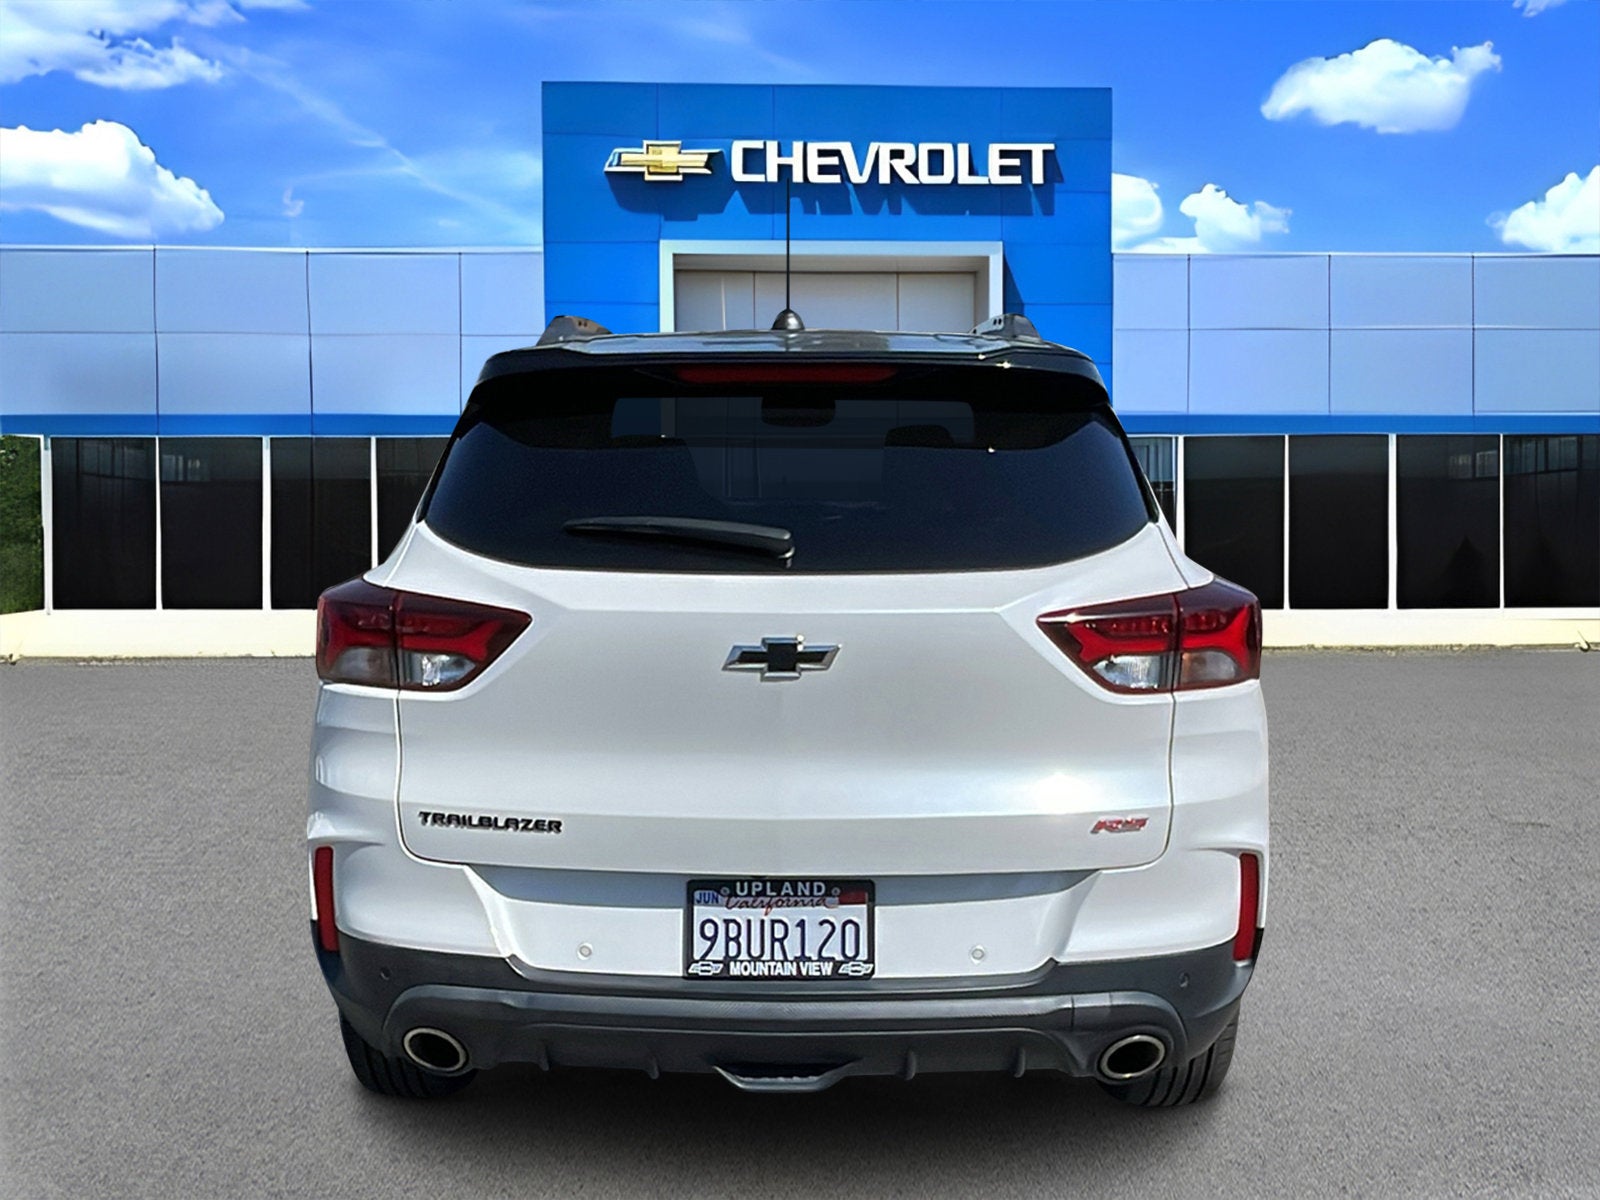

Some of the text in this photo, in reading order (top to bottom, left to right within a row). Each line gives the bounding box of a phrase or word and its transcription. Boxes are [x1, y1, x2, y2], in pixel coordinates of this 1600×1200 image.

[731, 140, 1054, 184] CHEVROLET
[419, 811, 562, 833] TRAILBLAZER
[736, 881, 826, 896] UPLAND
[695, 892, 719, 904] JUN
[699, 919, 860, 960] 9BUR120
[729, 961, 833, 976] MOUNTAIN VIEW
